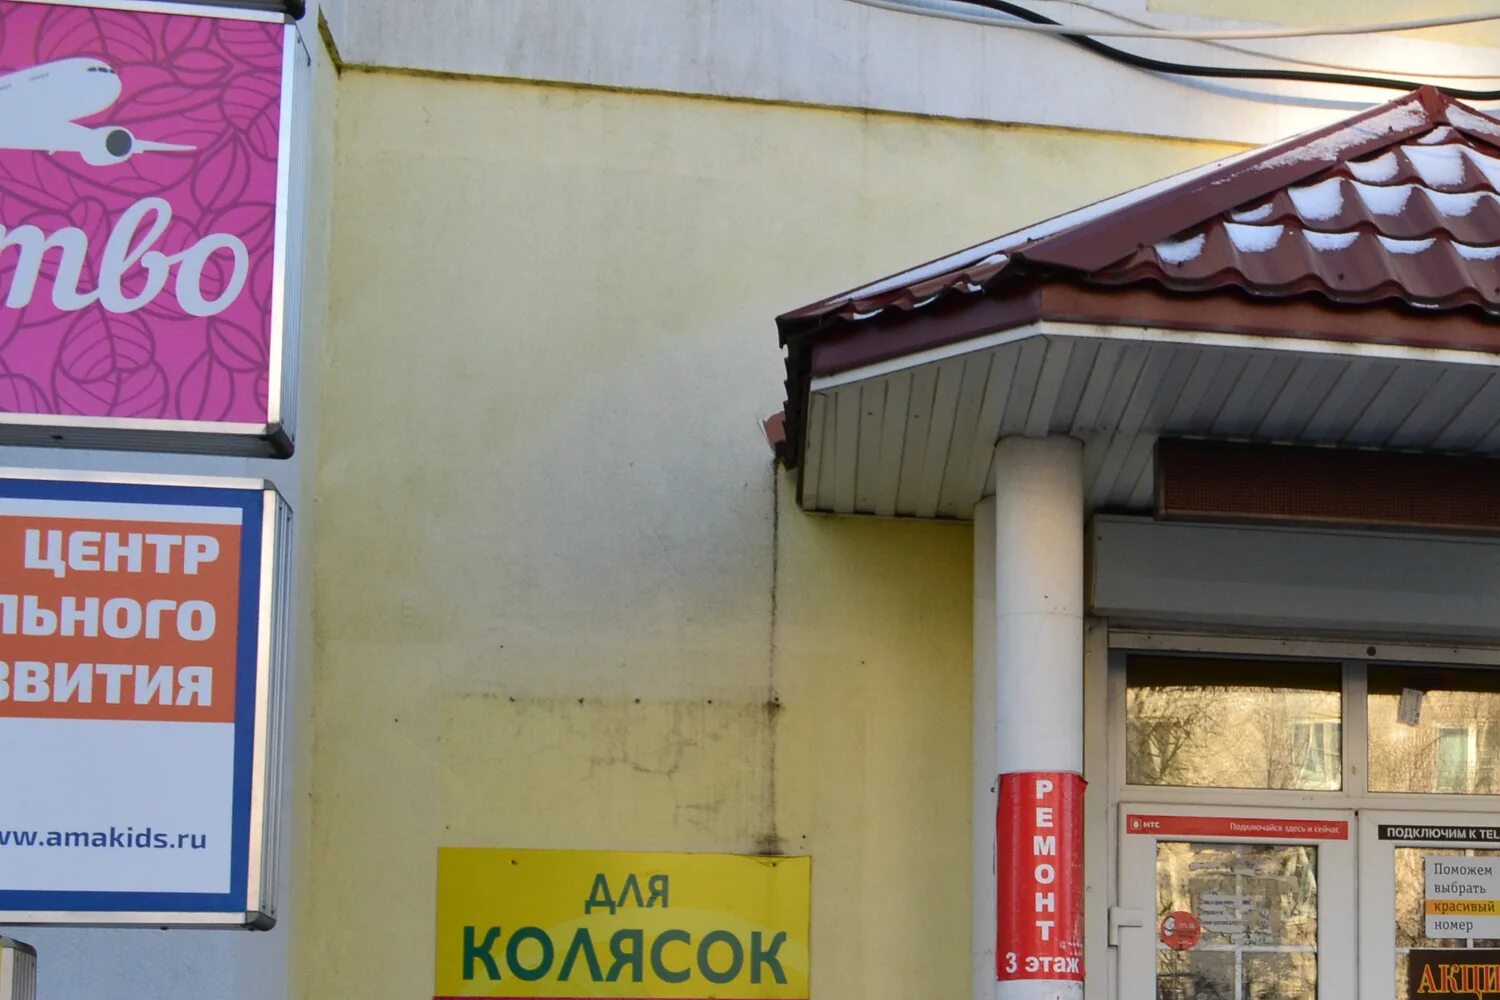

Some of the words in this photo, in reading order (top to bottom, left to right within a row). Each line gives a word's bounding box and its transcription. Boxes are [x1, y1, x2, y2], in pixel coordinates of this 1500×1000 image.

[24, 529, 220, 578] ЦЕНТР
[0, 661, 213, 706] ВИТИЯ
[1387, 828, 1466, 839] ПОДКЛЮЧИМ
[1469, 829, 1477, 839] К
[1434, 863, 1492, 875] Поможем
[584, 873, 669, 915] ДЛЯ
[1434, 881, 1486, 896] выбрать
[1434, 900, 1495, 914] красивый
[1434, 920, 1473, 932] номер
[462, 925, 787, 984] КОЛЯСОК
[1005, 952, 1017, 973] 3
[1025, 956, 1079, 973] этаж
